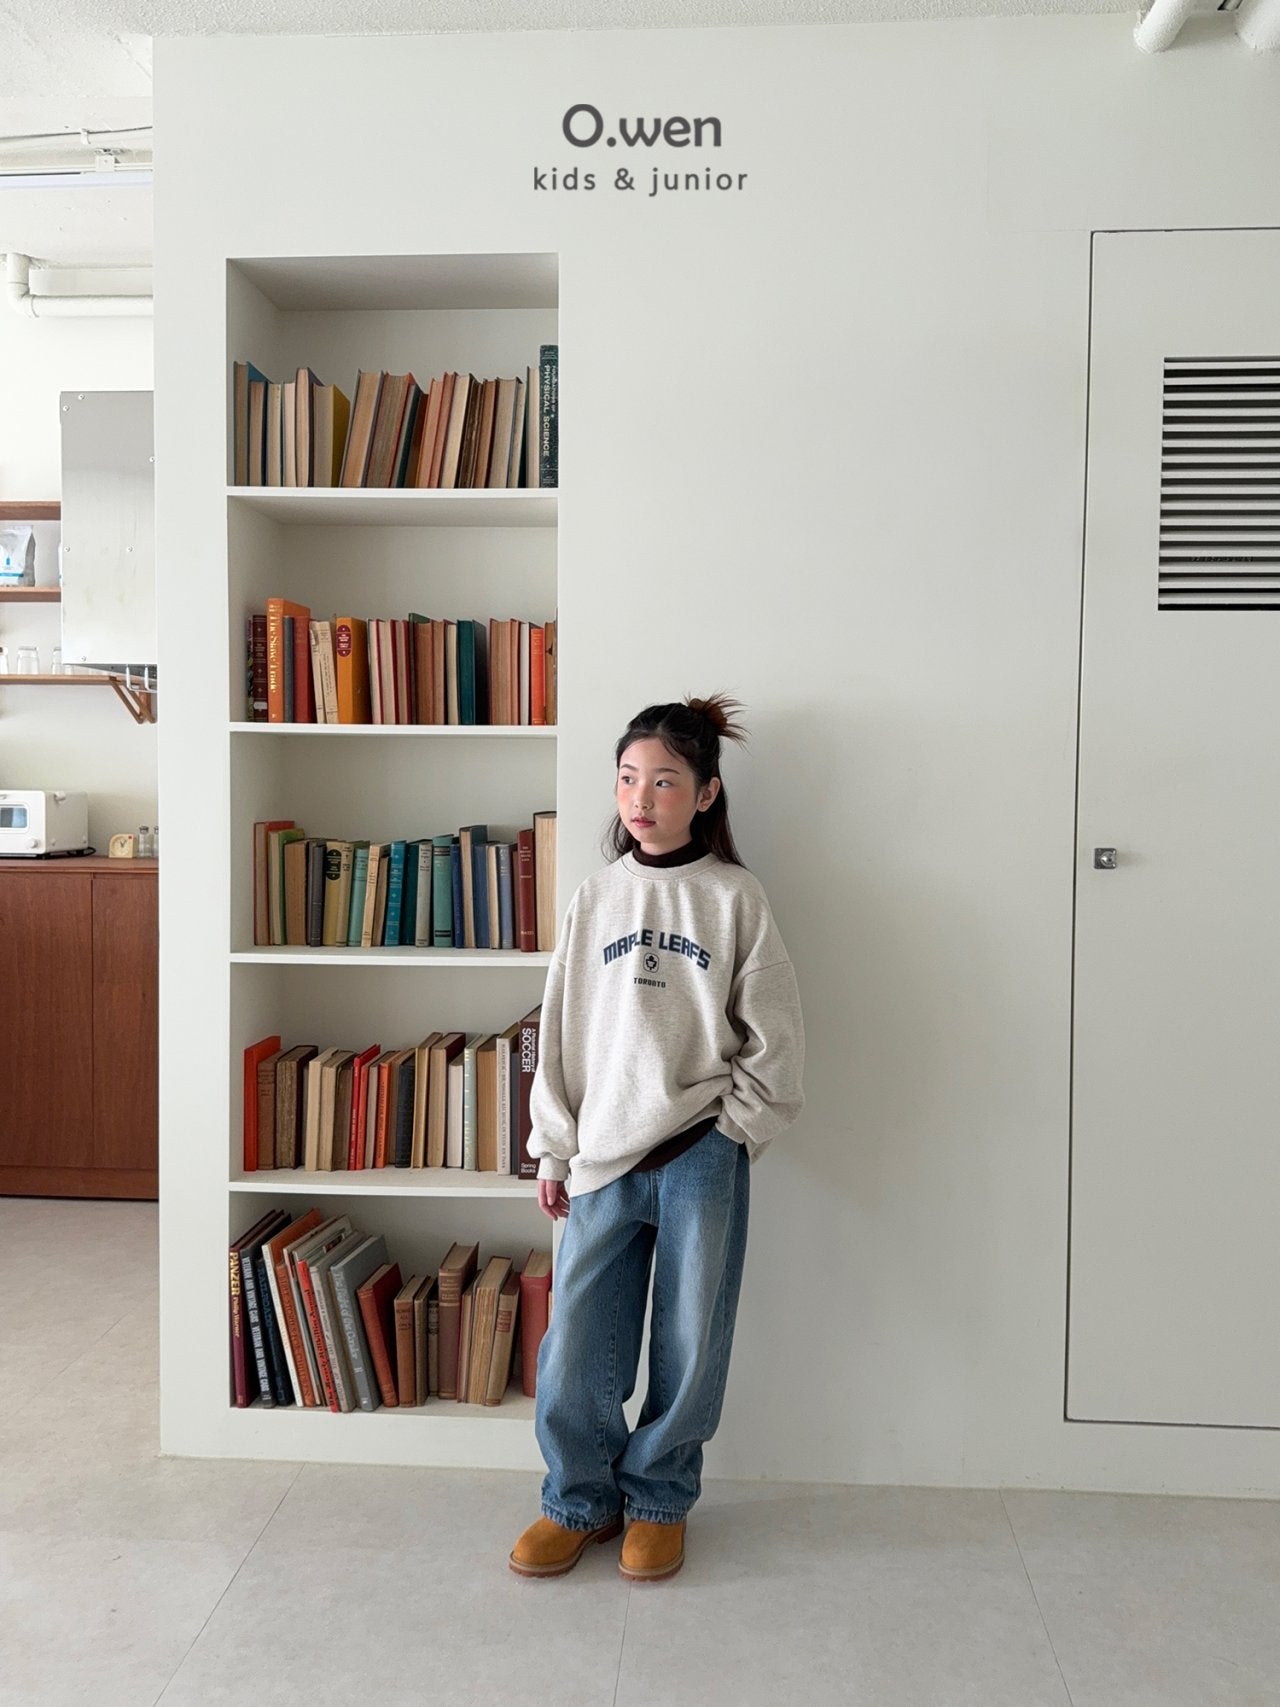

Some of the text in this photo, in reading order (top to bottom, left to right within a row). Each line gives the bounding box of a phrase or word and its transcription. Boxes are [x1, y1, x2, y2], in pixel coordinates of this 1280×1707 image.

[658, 931, 711, 971] LEAFS
[634, 978, 666, 988] TORONTO
[522, 1028, 532, 1072] SOCCER
[230, 1252, 240, 1296] PANZER
[242, 1256, 253, 1279] VETERAN
[246, 1290, 258, 1310] VINTAGE
